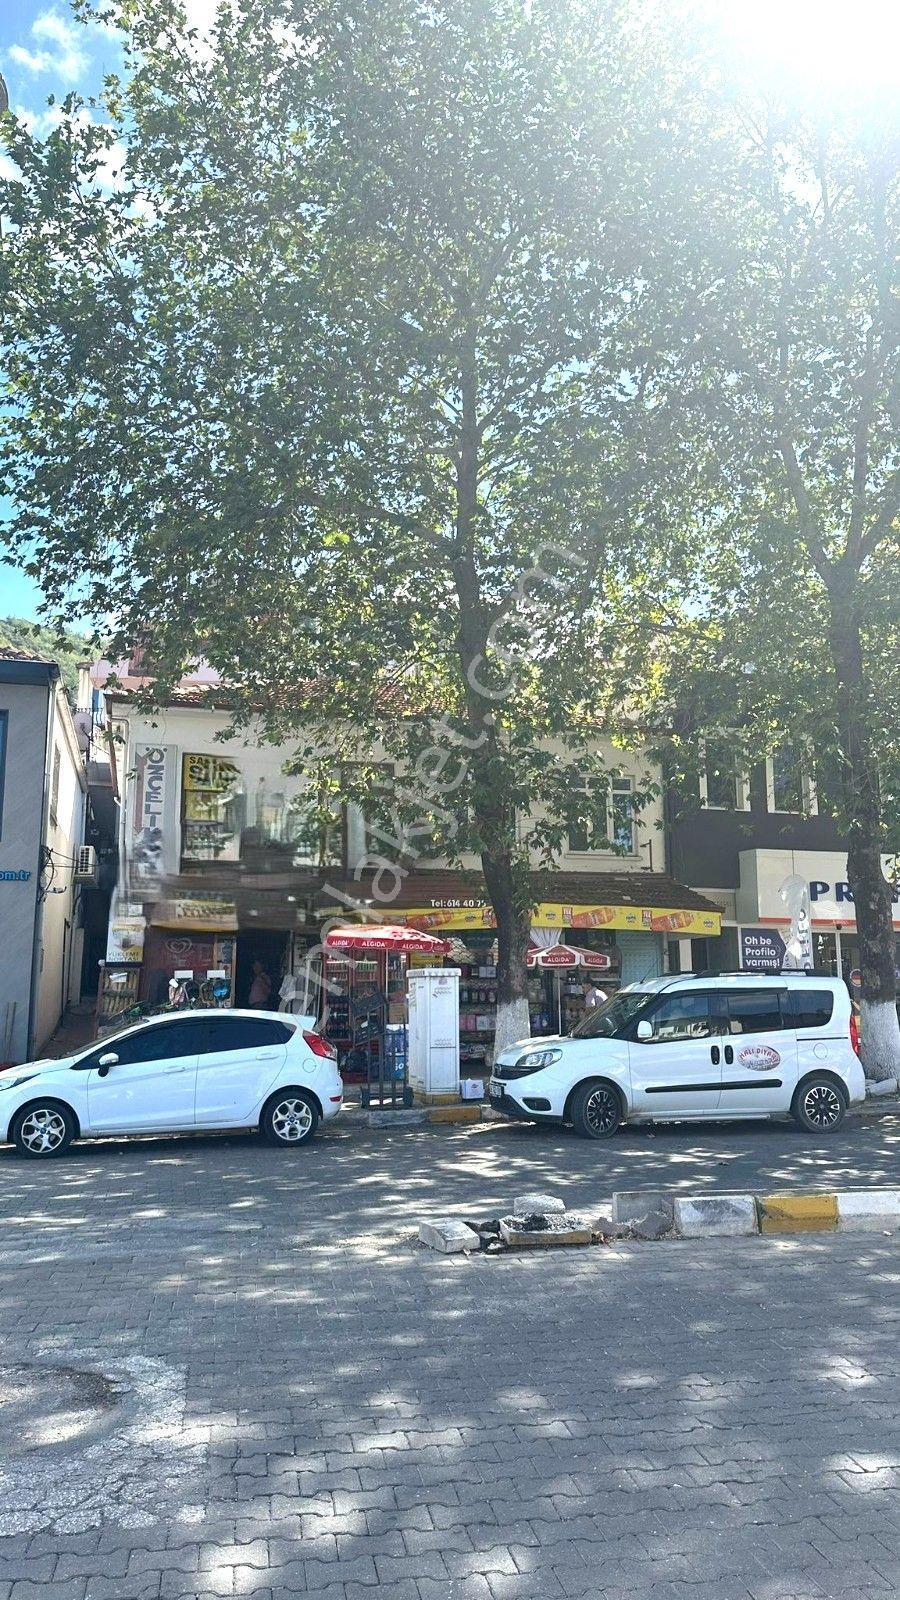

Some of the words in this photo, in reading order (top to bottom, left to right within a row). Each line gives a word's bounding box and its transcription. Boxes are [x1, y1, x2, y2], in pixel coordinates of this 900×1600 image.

[744, 936, 758, 945] Oh
[760, 936, 771, 945] be
[745, 947, 776, 956] Profilo
[745, 958, 780, 968] varmış!
